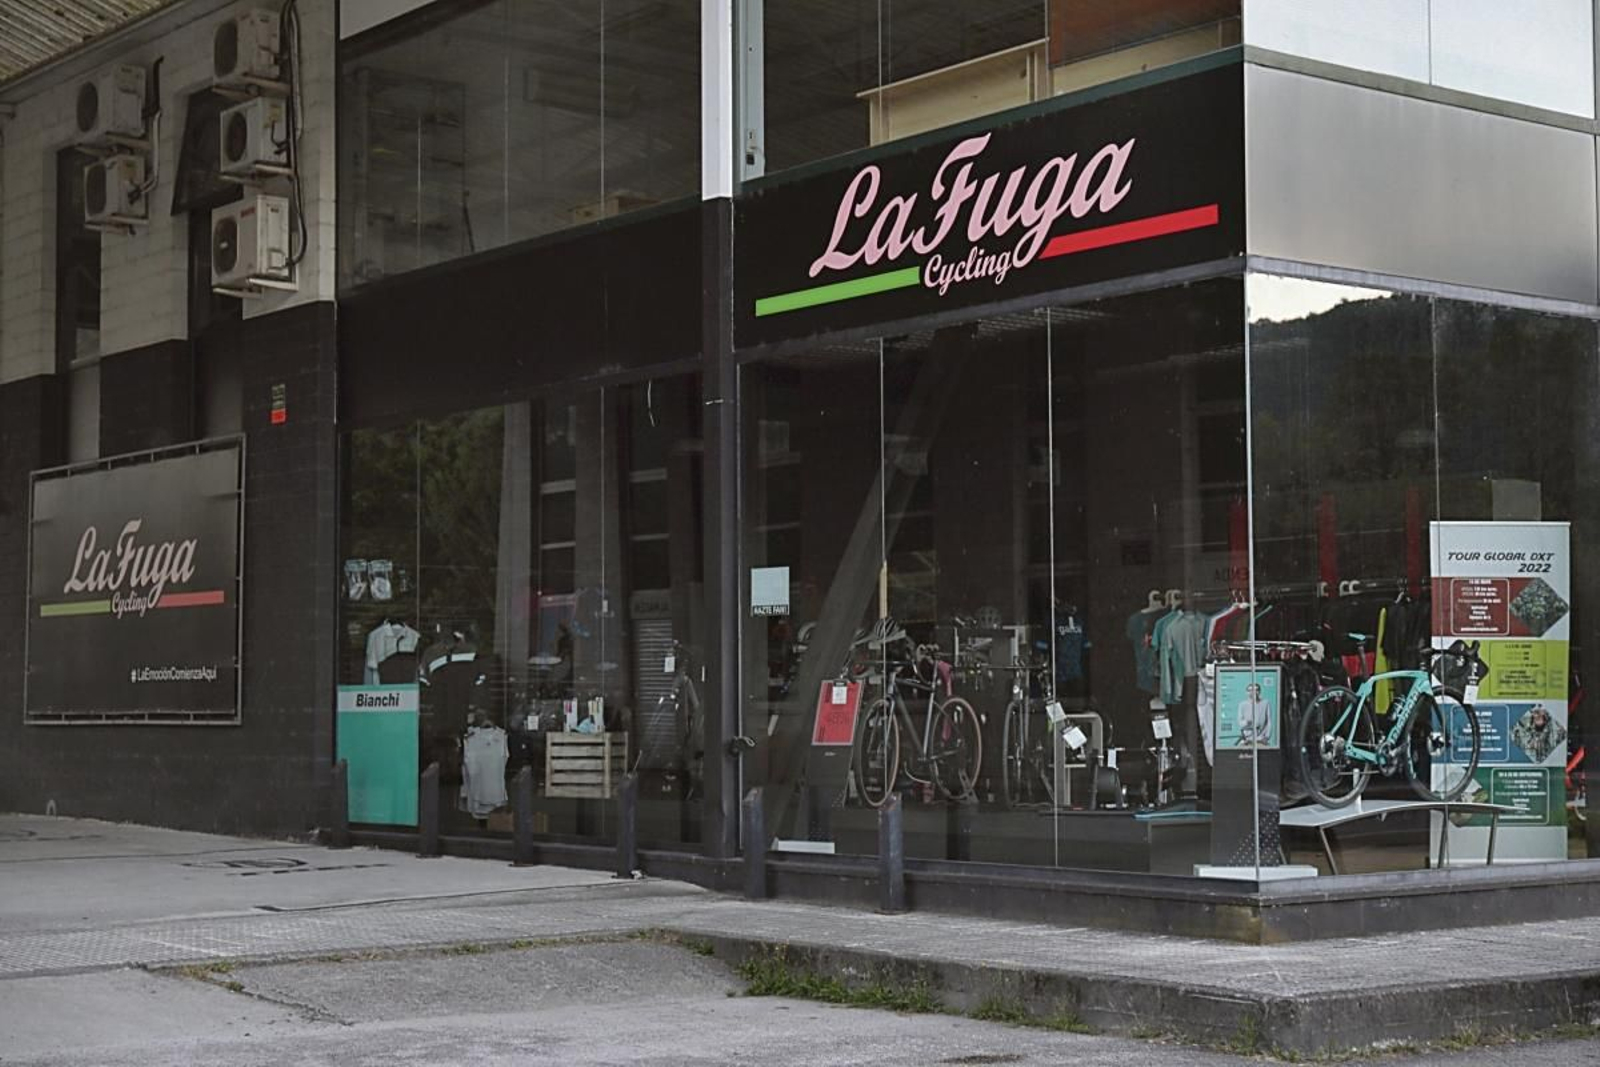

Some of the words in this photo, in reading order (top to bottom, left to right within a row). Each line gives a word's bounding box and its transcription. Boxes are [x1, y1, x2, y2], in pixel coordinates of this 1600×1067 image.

[924, 248, 1013, 296] Cycling
[1447, 551, 1481, 561] TOUR
[1484, 551, 1527, 561] GLOBAL
[1530, 552, 1555, 561] DXT
[1518, 563, 1552, 573] 2022
[111, 591, 147, 619] Cycling
[355, 693, 400, 707] Bianchi
